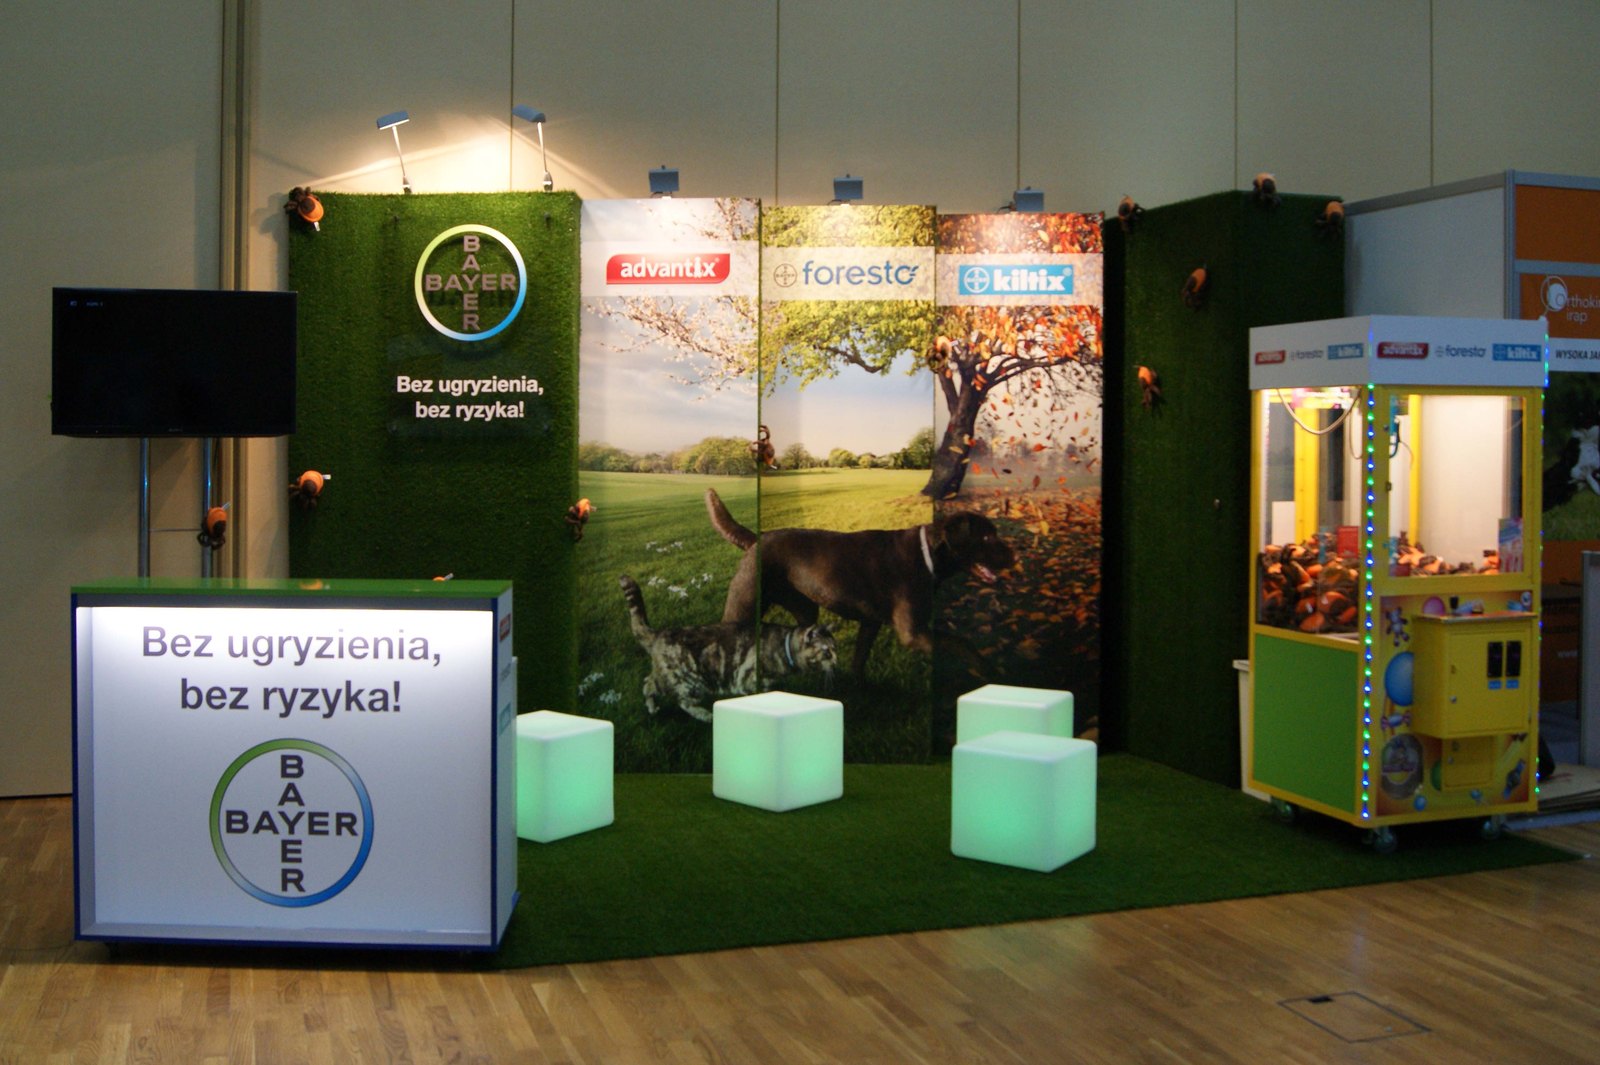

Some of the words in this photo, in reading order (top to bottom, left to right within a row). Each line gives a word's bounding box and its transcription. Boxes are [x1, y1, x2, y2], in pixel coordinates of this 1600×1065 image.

[620, 256, 716, 278] advantix
[802, 260, 919, 285] foresto
[425, 273, 516, 291] BAYER
[461, 235, 481, 331] BAYER
[993, 268, 1066, 291] kiltix
[1445, 344, 1487, 358] foresto
[397, 376, 433, 392] Bez
[438, 376, 544, 396] ugryzienia,
[415, 401, 450, 418] bez
[456, 401, 525, 421] ryzyka!
[142, 626, 213, 657] Bez
[228, 629, 441, 666] ugryzienia,
[181, 678, 249, 710] bez
[263, 680, 401, 719] ryzyka!
[226, 810, 358, 836] BAYER
[278, 755, 305, 892] BAYER
